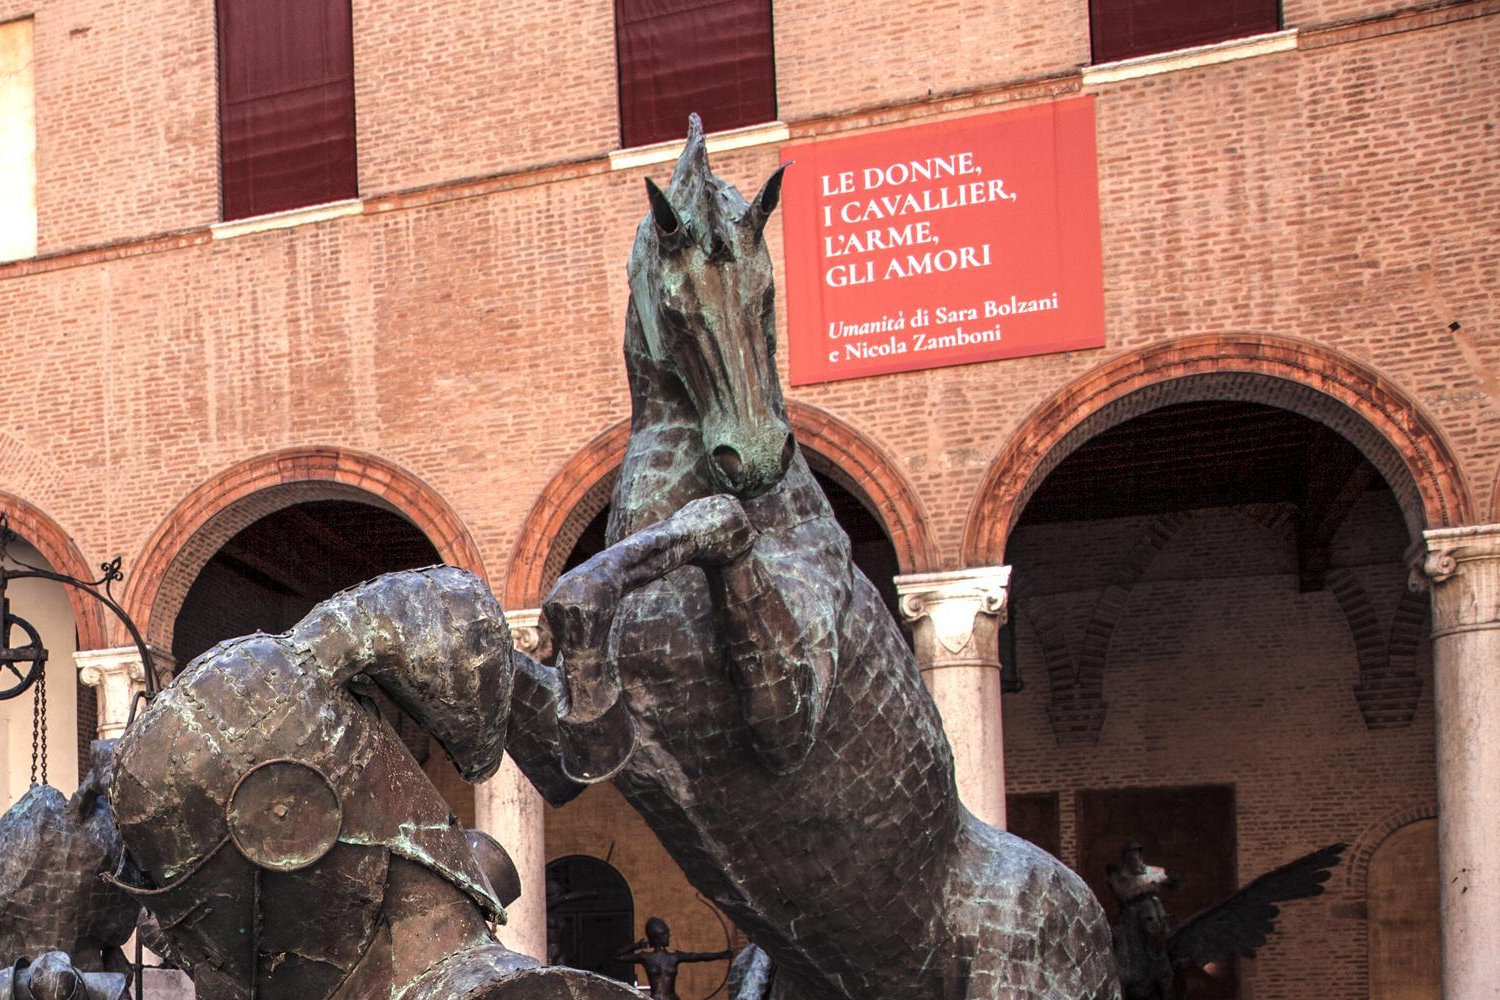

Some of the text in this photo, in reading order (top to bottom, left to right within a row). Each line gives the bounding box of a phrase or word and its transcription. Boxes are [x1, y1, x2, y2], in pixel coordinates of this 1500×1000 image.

[821, 152, 982, 197] LE DONNE,
[822, 178, 1017, 228] I CAVALLIER,
[824, 221, 940, 258] L’ARME,
[825, 244, 992, 288] GLI AMORI
[828, 292, 1059, 339] Umanità di Sara Bolzani
[828, 324, 1002, 363] e Nicola Zamboni
